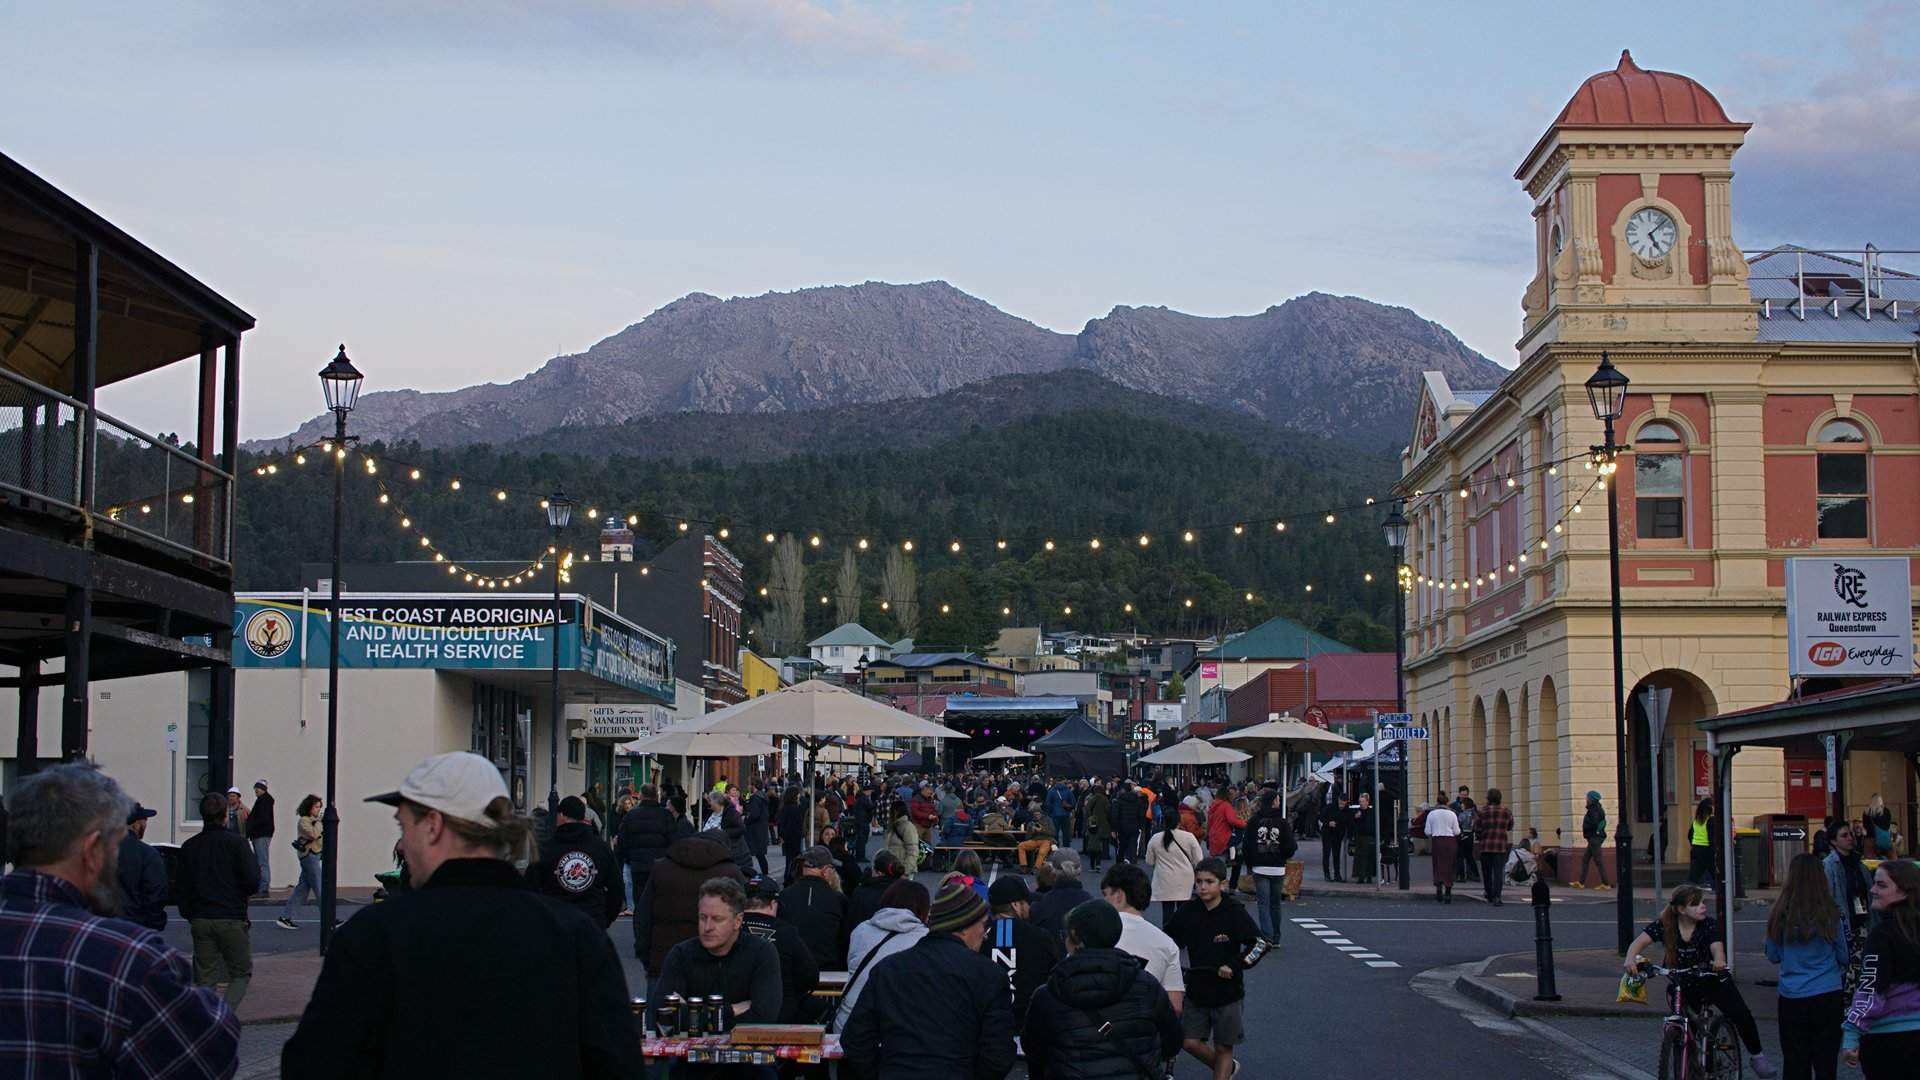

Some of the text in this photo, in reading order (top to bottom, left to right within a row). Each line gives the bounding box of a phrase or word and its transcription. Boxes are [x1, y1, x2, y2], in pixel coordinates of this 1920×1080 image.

[382, 608, 446, 623] COAST
[450, 608, 568, 623] ABORIGINAL
[1817, 612, 1887, 621] RAILWAY EXPRESS
[346, 626, 545, 641] AND MULTICULTURAL
[1829, 623, 1876, 633] Queenstown
[366, 644, 524, 659] HEALTH SERVICE
[1812, 646, 1903, 666] IGA Everyday
[594, 707, 614, 715] GIFTS
[1394, 727, 1421, 739] TOILET
